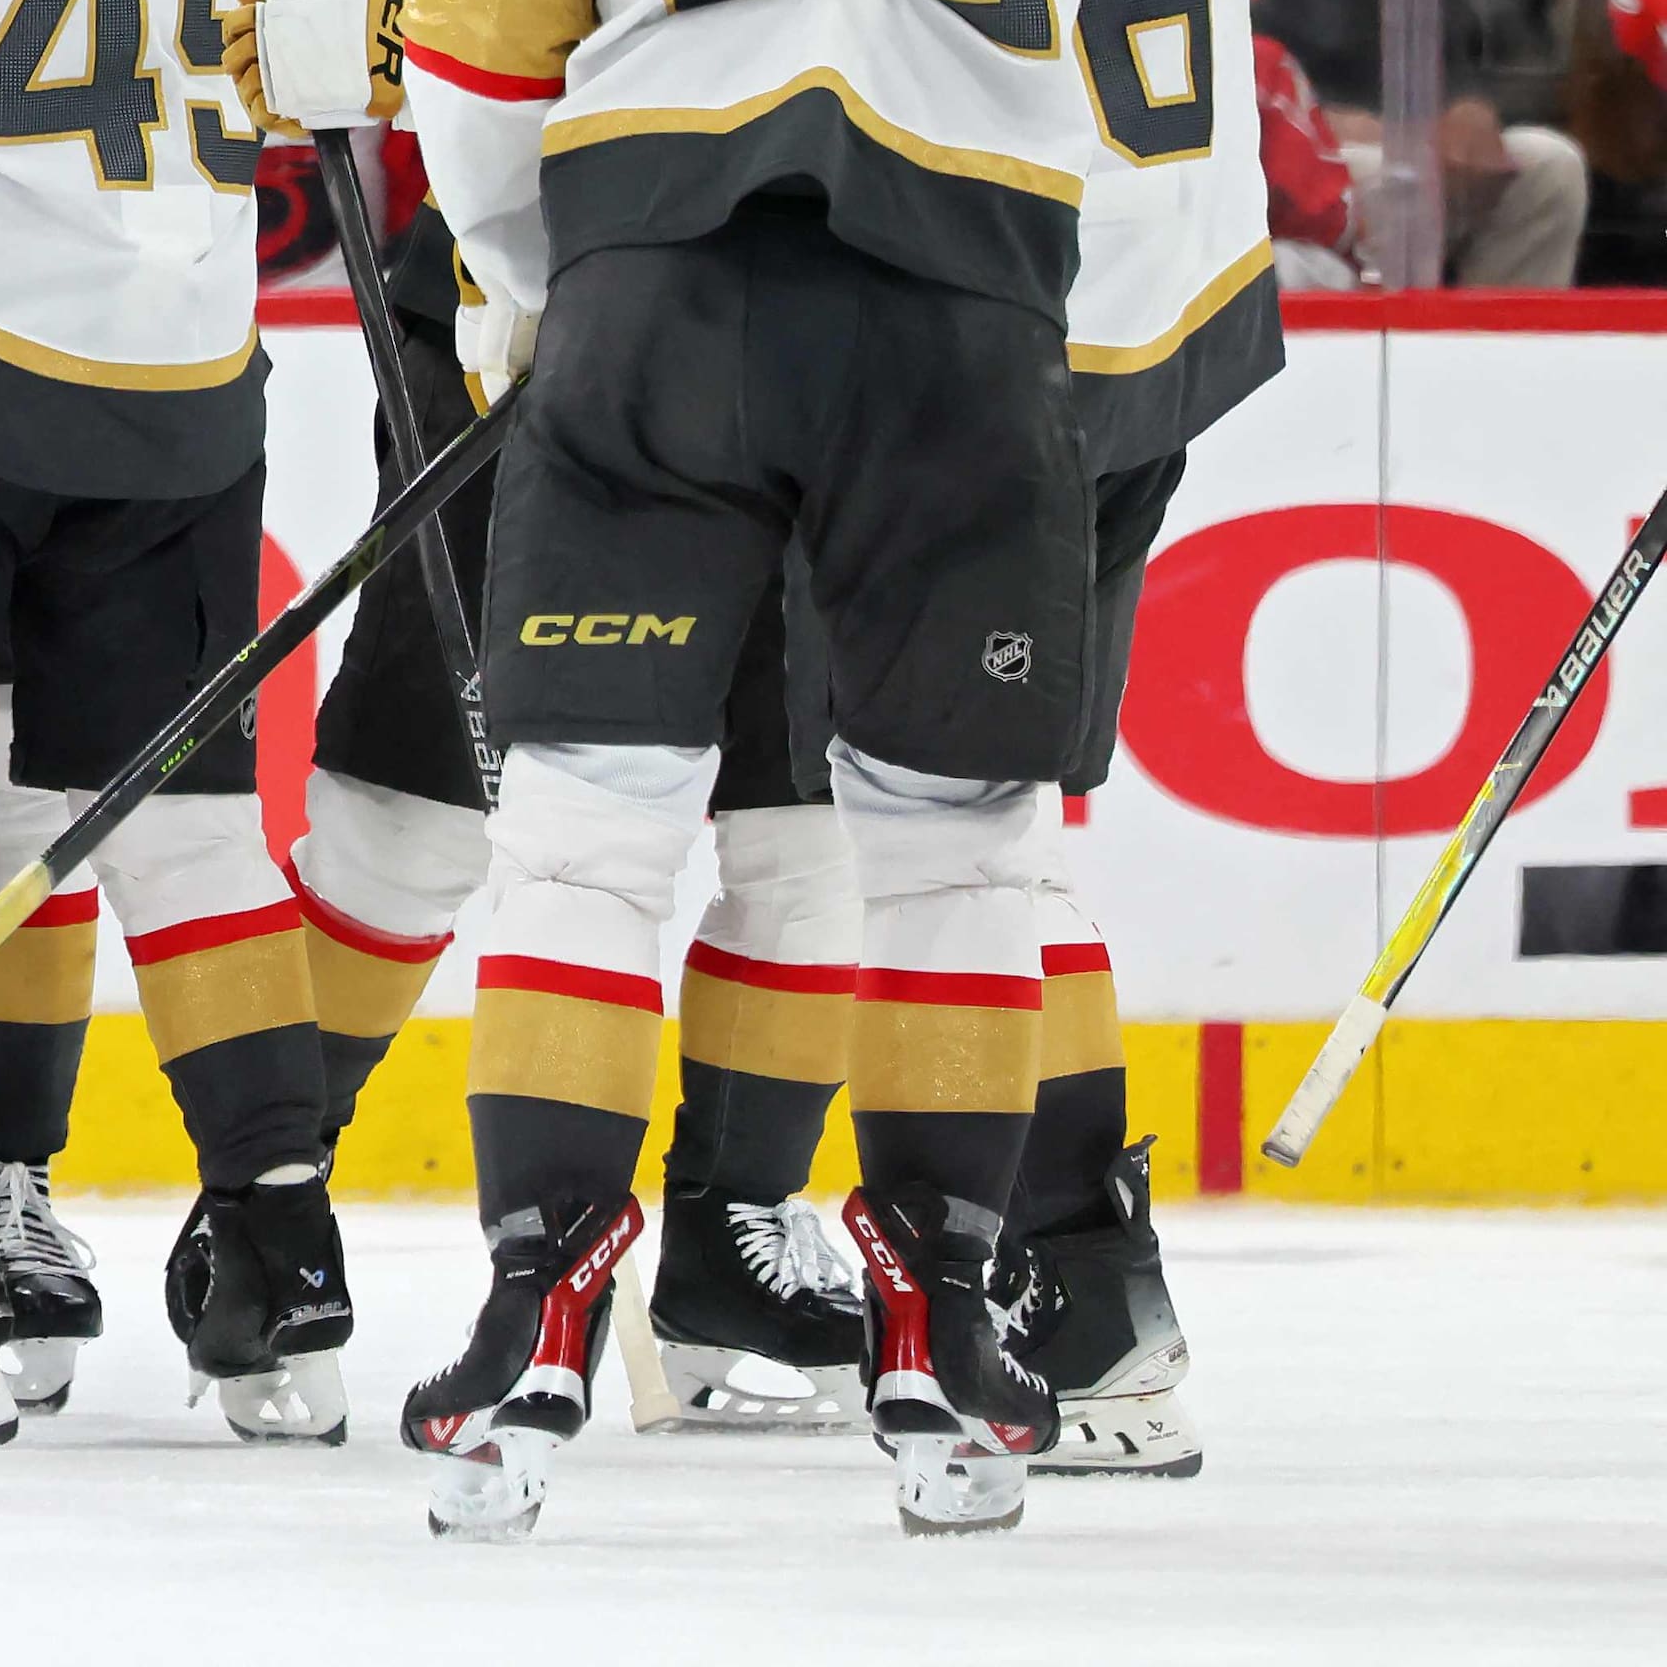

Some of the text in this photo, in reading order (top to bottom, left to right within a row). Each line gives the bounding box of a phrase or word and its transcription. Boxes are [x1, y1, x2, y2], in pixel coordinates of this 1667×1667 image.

[520, 614, 697, 646] CCM
[993, 642, 1023, 669] NHL
[1559, 548, 1654, 693] BAUER
[569, 1215, 630, 1293] CCM
[855, 1212, 913, 1292] CCM
